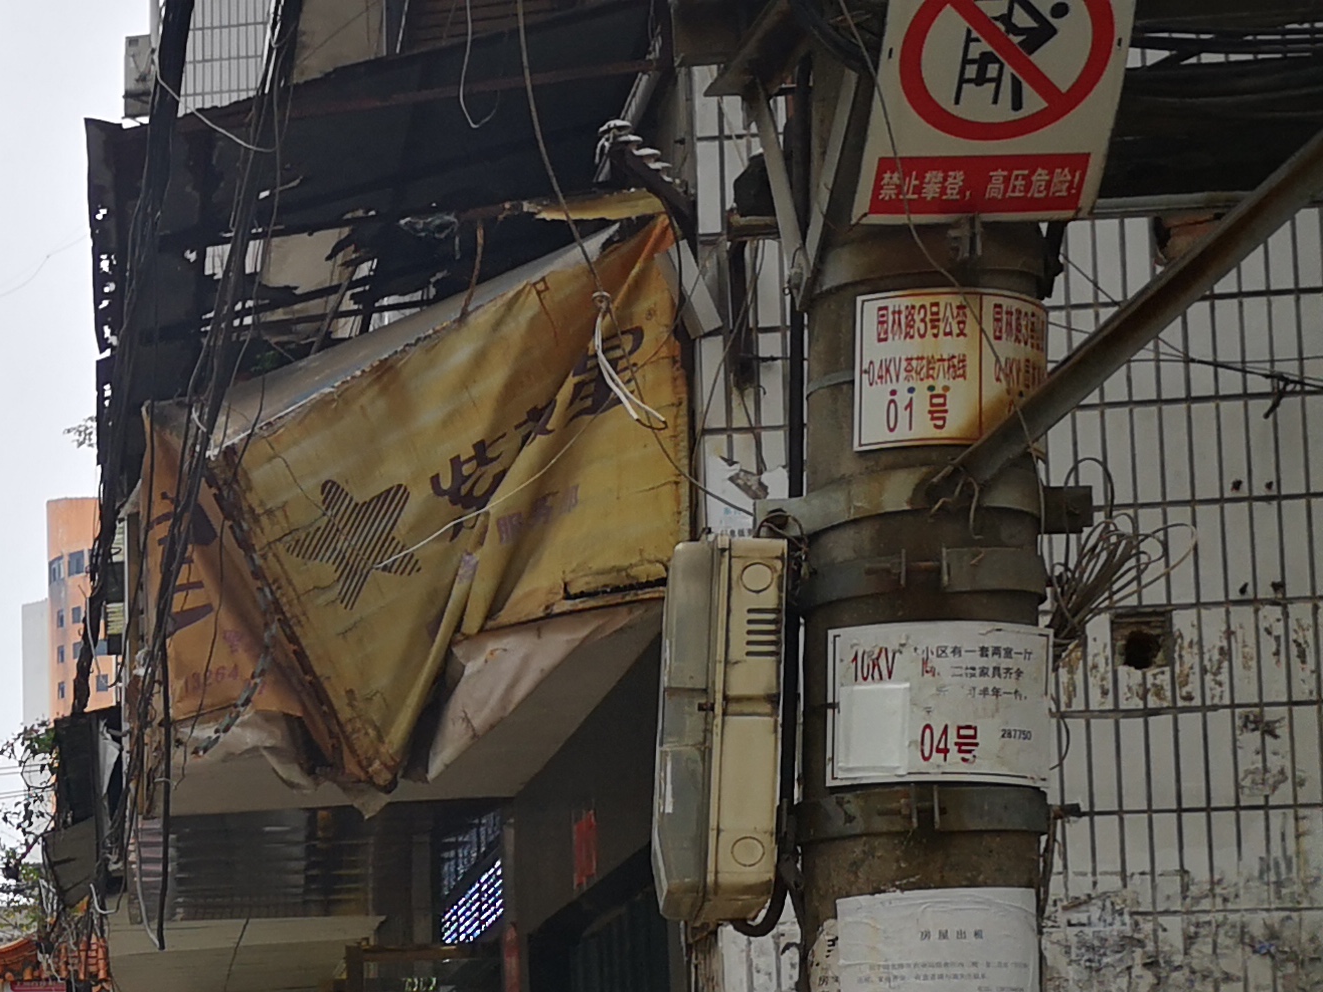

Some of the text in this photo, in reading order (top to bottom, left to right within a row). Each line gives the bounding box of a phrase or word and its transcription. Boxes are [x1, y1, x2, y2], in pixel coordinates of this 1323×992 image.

[876, 301, 968, 342] 园林路3号公变
[885, 393, 949, 432] 01号
[919, 723, 979, 764] 04号
